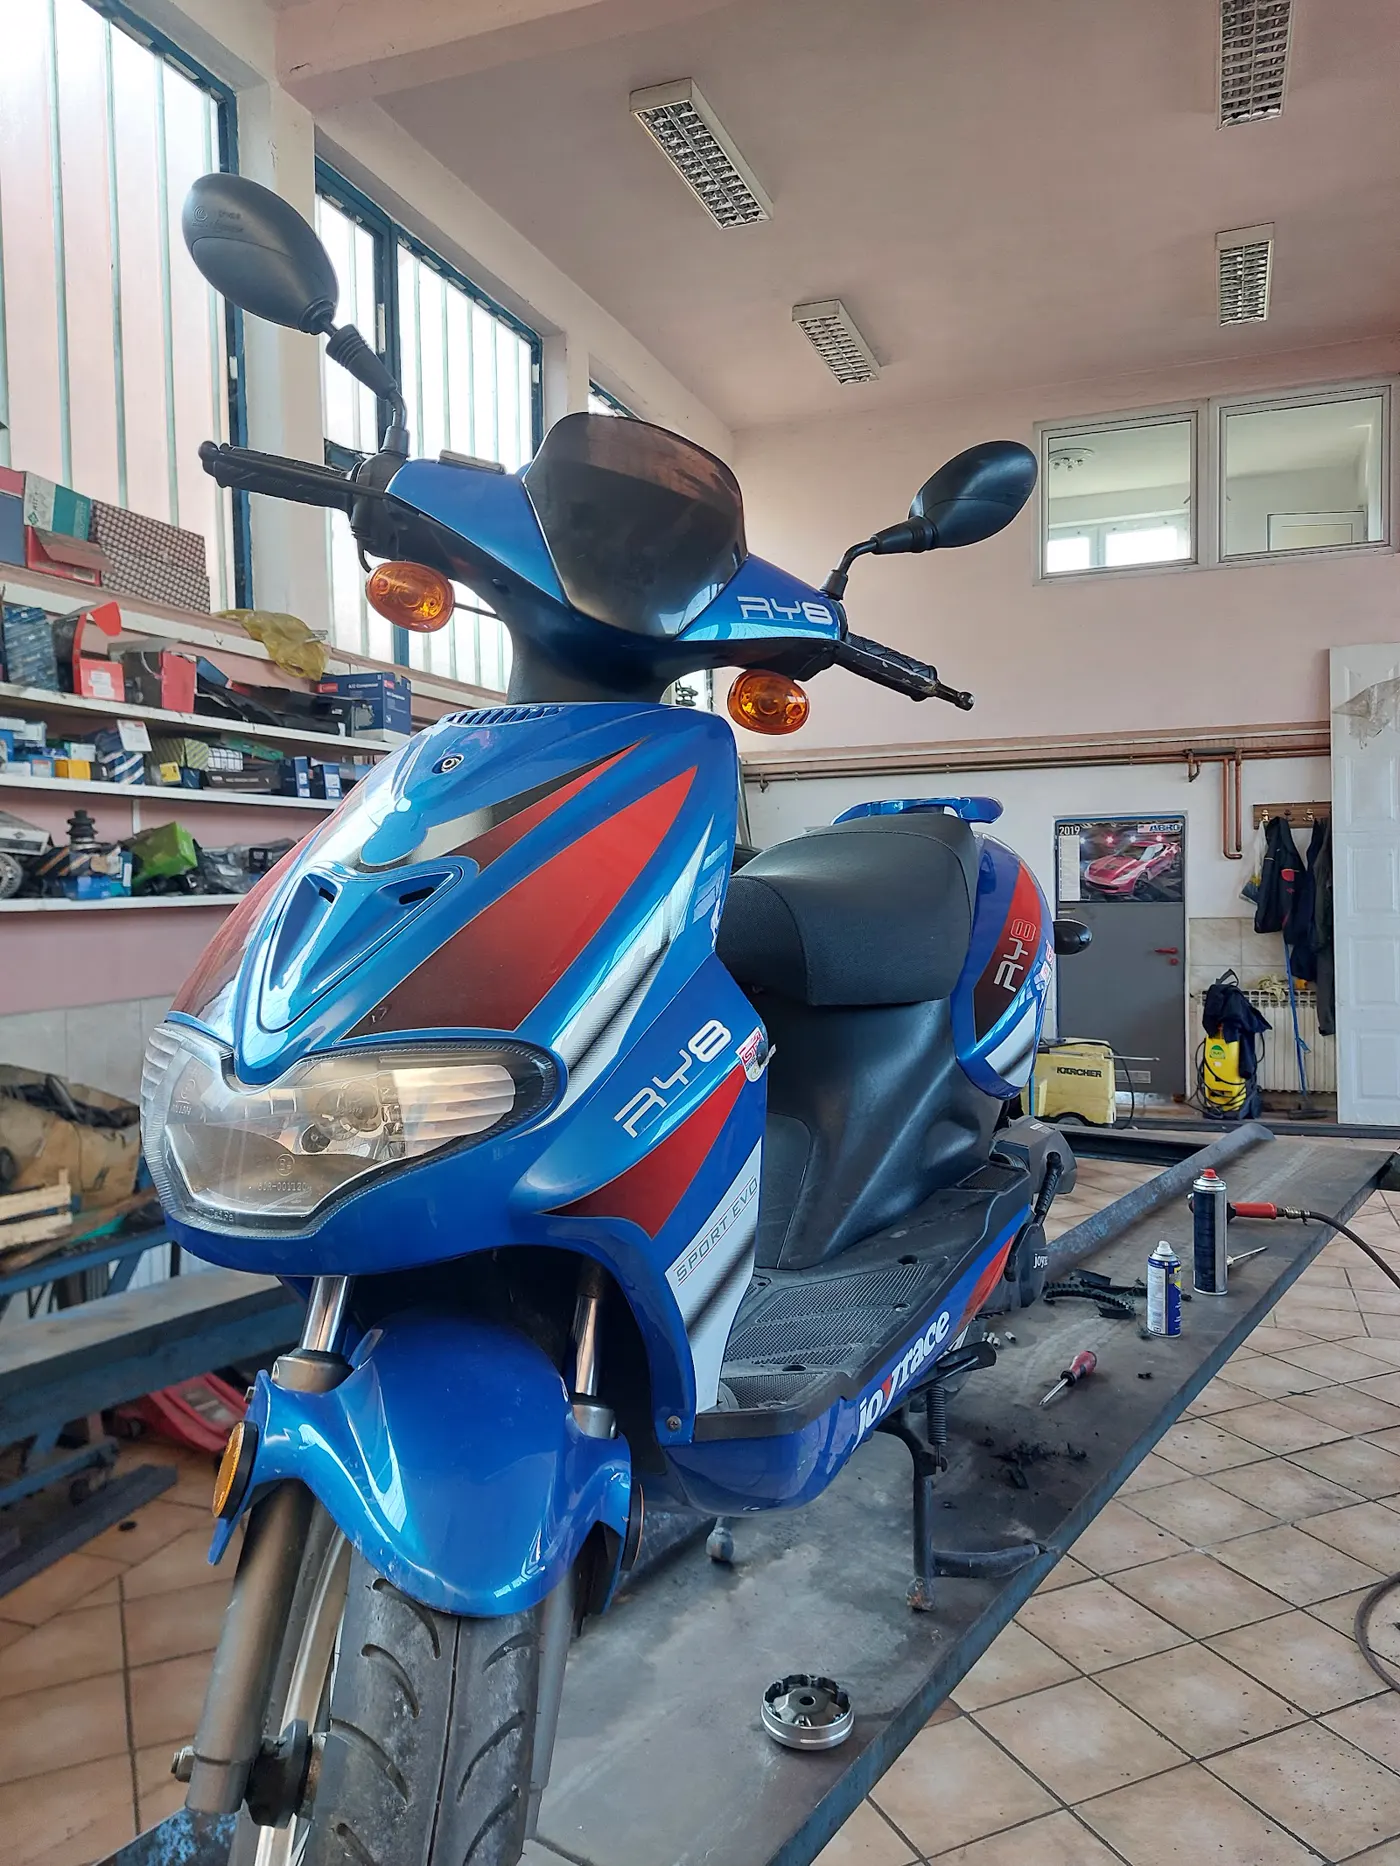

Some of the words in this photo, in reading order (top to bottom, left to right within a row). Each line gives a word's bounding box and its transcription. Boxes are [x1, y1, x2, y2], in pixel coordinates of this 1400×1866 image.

[737, 596, 833, 625] RY8
[1059, 826, 1080, 835] 2019
[1149, 824, 1181, 833] ABRO
[613, 1019, 732, 1138] RY8
[676, 1216, 728, 1282] SPORT
[732, 1177, 758, 1218] EVO
[851, 1311, 950, 1453] joyrace
